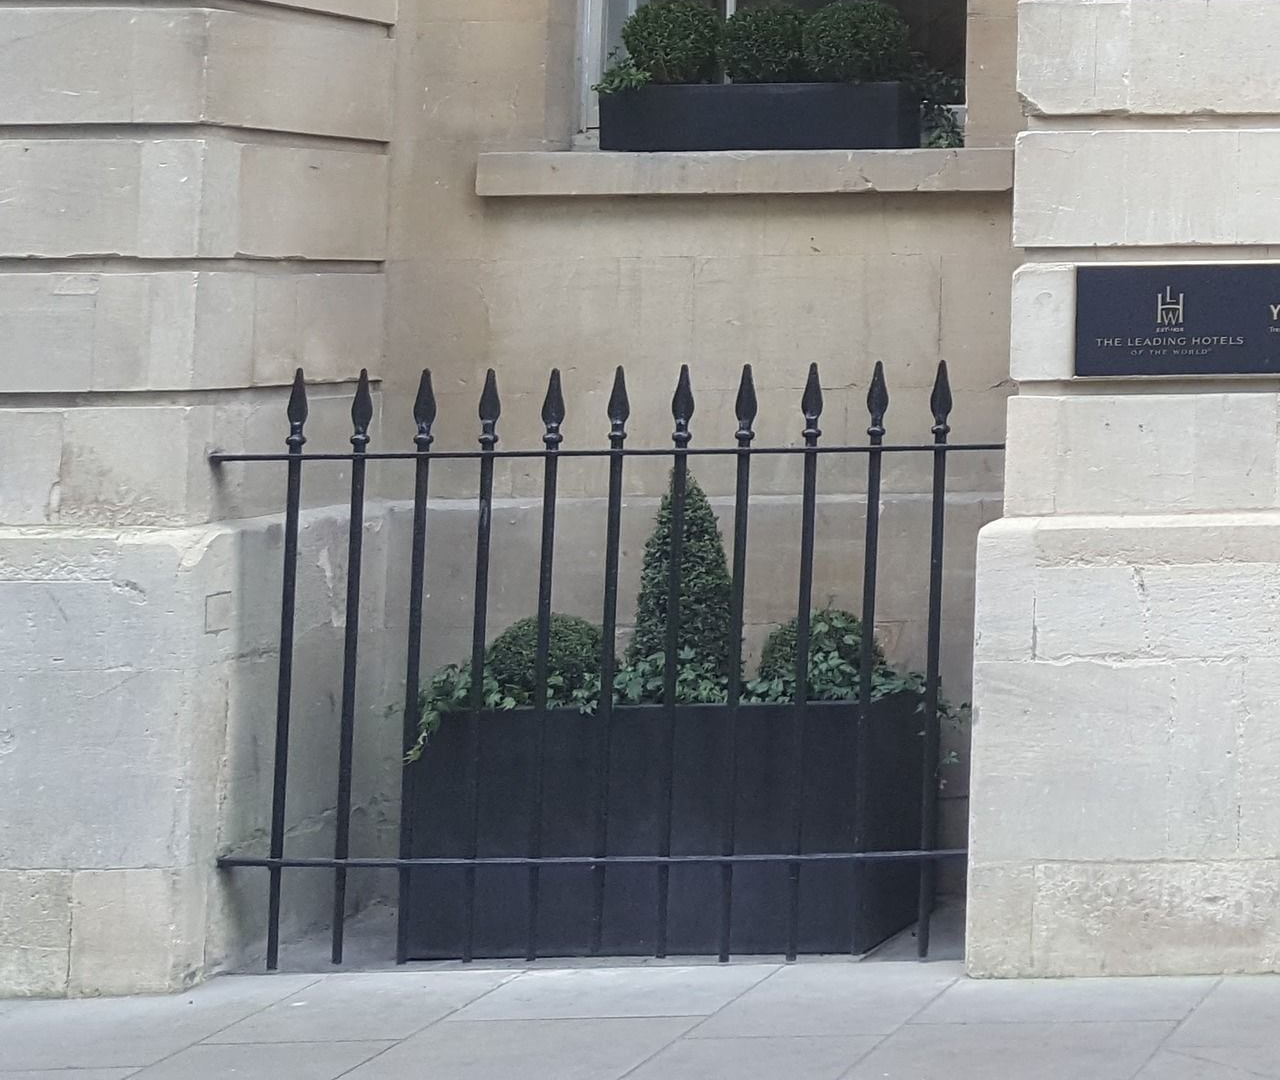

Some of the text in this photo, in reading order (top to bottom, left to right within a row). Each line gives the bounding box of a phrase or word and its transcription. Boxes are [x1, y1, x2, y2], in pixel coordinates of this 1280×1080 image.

[1095, 336, 1244, 347] THE LEADING HOTELS
[1149, 348, 1168, 356] THE
